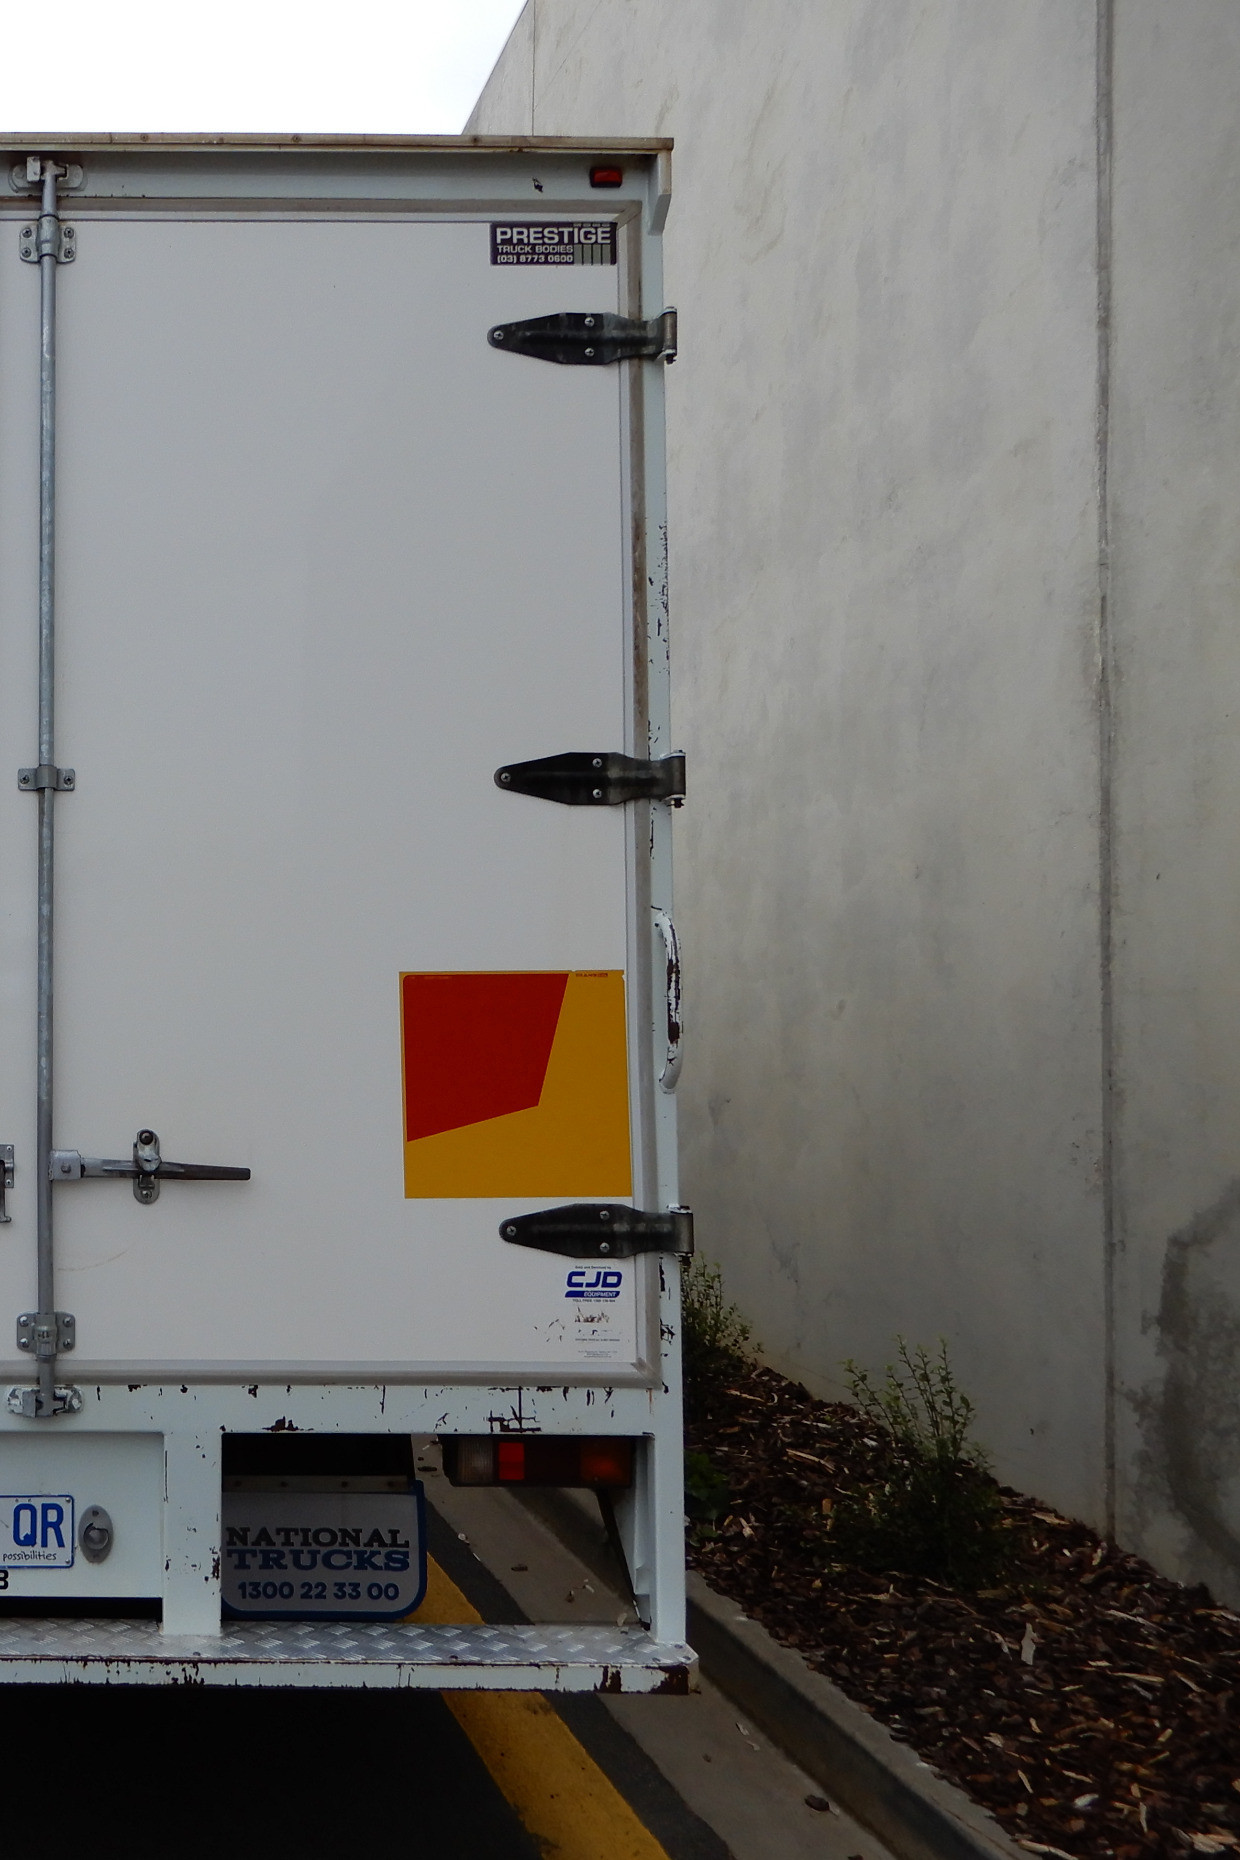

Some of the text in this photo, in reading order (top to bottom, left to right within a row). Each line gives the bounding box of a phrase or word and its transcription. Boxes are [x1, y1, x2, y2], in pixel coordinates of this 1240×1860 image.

[496, 227, 611, 244] PRESTIGE
[497, 245, 573, 253] TRUCK BODIES
[497, 254, 573, 263] (03) 8773 0600
[566, 1271, 623, 1288] CJD
[12, 1503, 65, 1548] QR
[226, 1526, 409, 1548] NATIONAL
[3, 1551, 57, 1562] possibilities
[226, 1549, 410, 1571] TRUCKS
[238, 1581, 400, 1601] 1300 22 33 00
